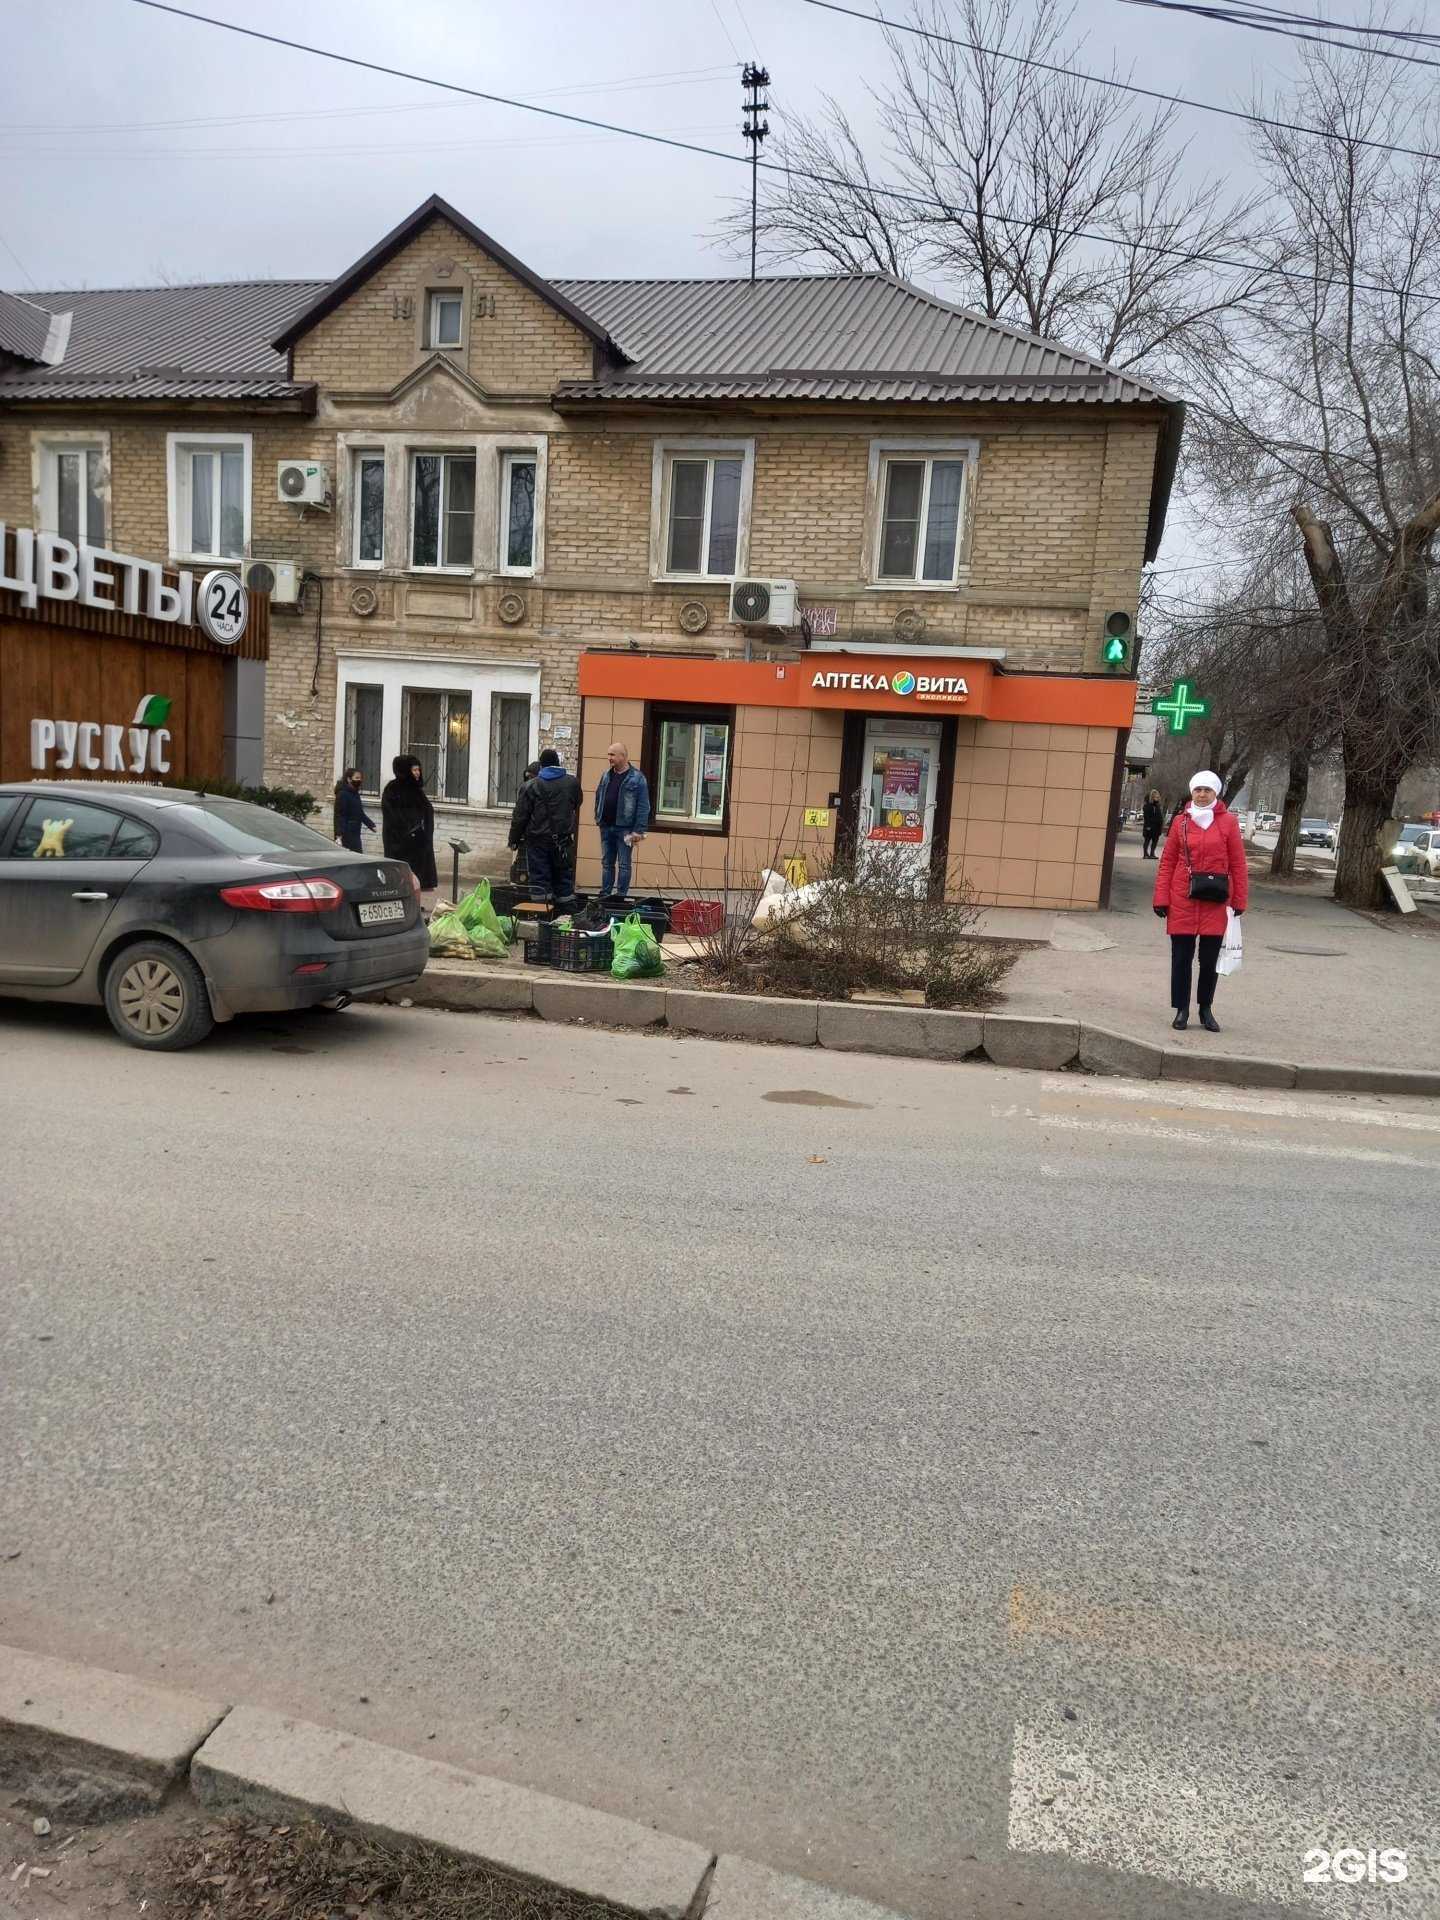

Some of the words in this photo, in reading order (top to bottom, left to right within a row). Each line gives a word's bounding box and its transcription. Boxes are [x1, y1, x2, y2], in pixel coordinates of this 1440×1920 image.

[0, 521, 193, 626] ЦВЕТЫ
[210, 584, 242, 623] 24
[217, 621, 235, 633] ЧАСА
[812, 671, 890, 691] АПТЕКА
[916, 676, 969, 694] ВИТА
[31, 718, 171, 774] РУСКУС
